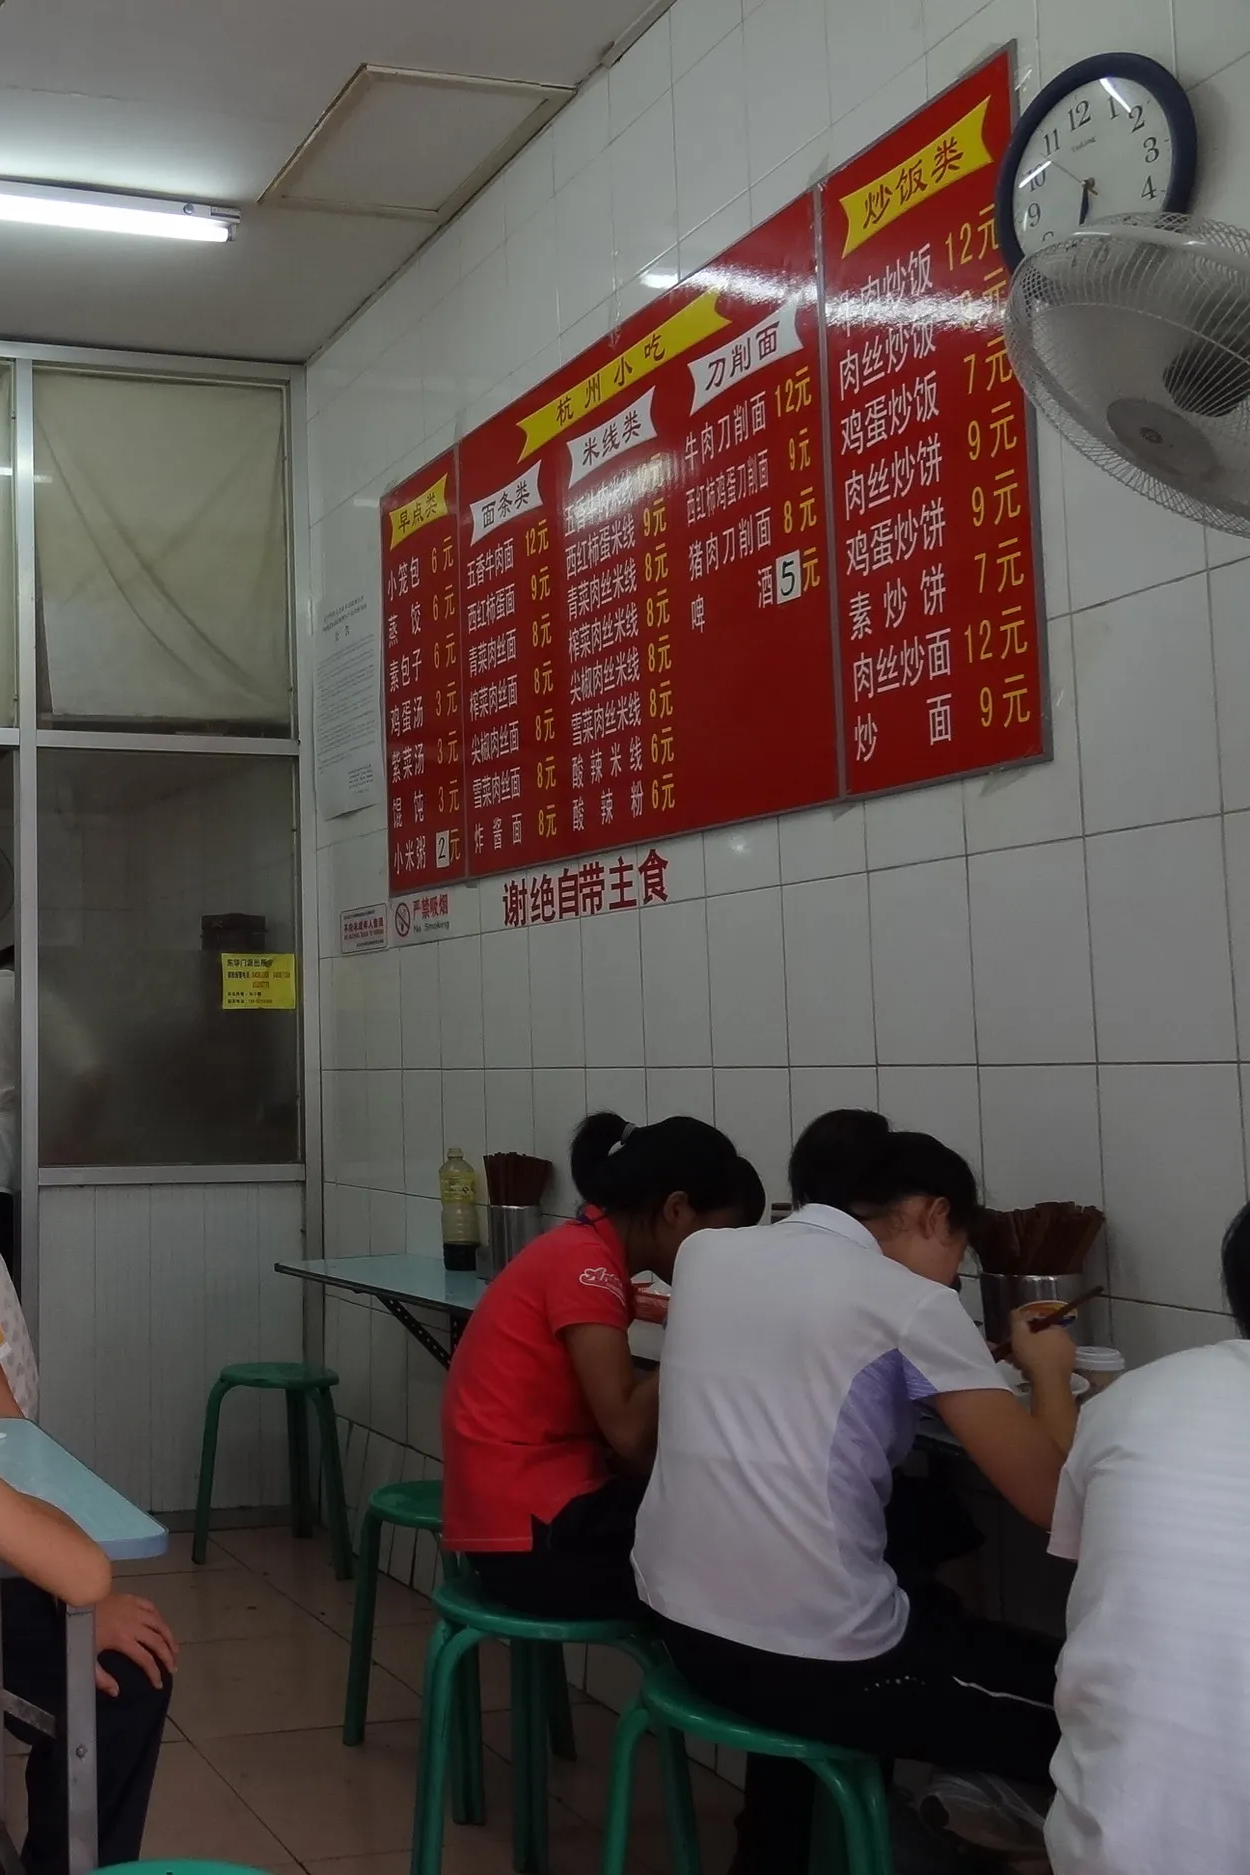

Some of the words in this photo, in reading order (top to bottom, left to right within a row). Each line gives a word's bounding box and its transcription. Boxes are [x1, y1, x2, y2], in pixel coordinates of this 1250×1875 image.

[1067, 100, 1092, 132] 12
[1107, 96, 1119, 120] 1
[1129, 104, 1145, 134] 2
[1043, 128, 1061, 157] 11
[1143, 136, 1160, 163] 3
[862, 136, 964, 230] 炒饭类
[1141, 175, 1157, 201] 4
[1028, 203, 1041, 228] 9
[837, 243, 933, 337] 肉炒饭
[945, 203, 999, 271] 12元
[555, 333, 666, 427] 杭州小吃
[705, 320, 780, 391] 刀削面
[684, 390, 767, 471] 牛肉刀削面
[775, 366, 812, 418] 12元
[840, 370, 939, 455] 鸡蛋炒饭
[964, 336, 1013, 395] 7元
[582, 409, 642, 466] 米线类
[844, 432, 943, 521] 肉丝炒饼
[967, 401, 1017, 461] 9元
[481, 479, 530, 530] 面条类
[686, 448, 769, 527] 西红柿鸡蛋刀削面
[788, 427, 811, 471] 9元
[398, 493, 437, 533] 早点类
[565, 515, 636, 580] 西红柿蛋米线
[643, 497, 667, 537] 9元
[689, 506, 772, 582] 猪肉刀削面
[783, 486, 817, 533] 8元
[846, 496, 946, 578] 鸡蛋炒饼
[971, 469, 1021, 527] 9元
[388, 557, 420, 601] 小笼包
[431, 536, 454, 573] 6元
[467, 537, 514, 590] 五香牛肉面
[525, 518, 549, 557] 12元
[567, 557, 637, 622] 青菜肉丝米线
[645, 543, 669, 582] 8元
[432, 584, 455, 621] 6元
[467, 583, 516, 635] 西红柿蛋面
[530, 566, 550, 601] 9元
[849, 562, 946, 641] 素炒饼
[974, 537, 1025, 593] 7元
[468, 628, 517, 679] 青菜肉丝面
[532, 613, 552, 648] 8元
[568, 601, 639, 664] 榨菜肉丝米线
[646, 589, 670, 627] 8元
[853, 627, 951, 702] 肉丝炒面
[964, 605, 1028, 664] 12元
[390, 648, 422, 692] 素包子
[434, 633, 456, 669] 6元
[469, 674, 518, 722] 榨菜肉丝面
[534, 660, 554, 695] 8元
[570, 646, 640, 705] 尖椒肉丝米线
[648, 634, 672, 674] 8元
[390, 696, 423, 737] 鸡蛋汤
[436, 681, 457, 716] 3元
[571, 691, 642, 746] 雪菜肉丝米线
[650, 680, 673, 719] 8元
[979, 673, 1031, 728] 9元
[392, 743, 425, 784] 紫菜汤
[437, 730, 459, 764] 3元
[471, 720, 519, 766] 尖椒肉丝面
[535, 708, 555, 743] 8元
[572, 735, 643, 789] 酸辣米线
[651, 726, 675, 765] 6元
[439, 779, 460, 813] 3元
[472, 766, 521, 809] 雪菜肉丝面
[536, 756, 557, 791] 8元
[651, 773, 675, 811] 6元
[538, 804, 557, 838] 8元
[394, 835, 426, 875] 小米粥
[413, 894, 448, 921] 严禁吸烟
[502, 849, 669, 928] 谢绝自带主食
